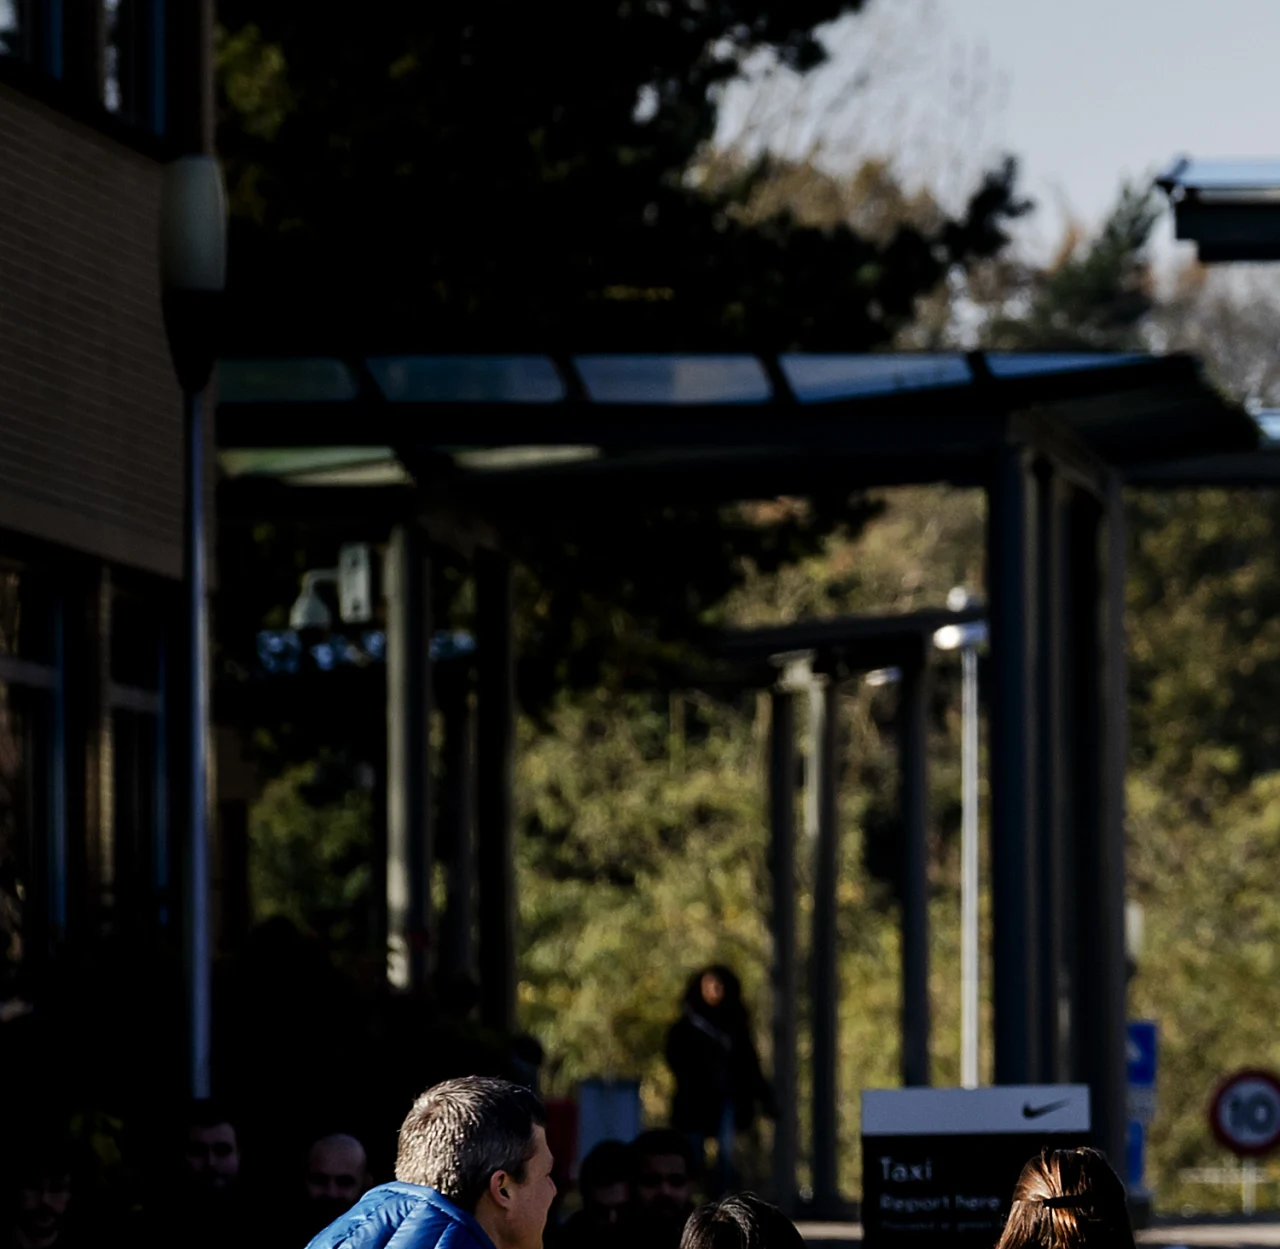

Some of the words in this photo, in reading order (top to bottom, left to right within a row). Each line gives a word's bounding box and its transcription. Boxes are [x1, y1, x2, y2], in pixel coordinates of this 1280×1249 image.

[1229, 1094, 1273, 1133] 10
[877, 1155, 933, 1183] Taxi
[879, 1192, 950, 1213] Report
[954, 1193, 1003, 1211] here
